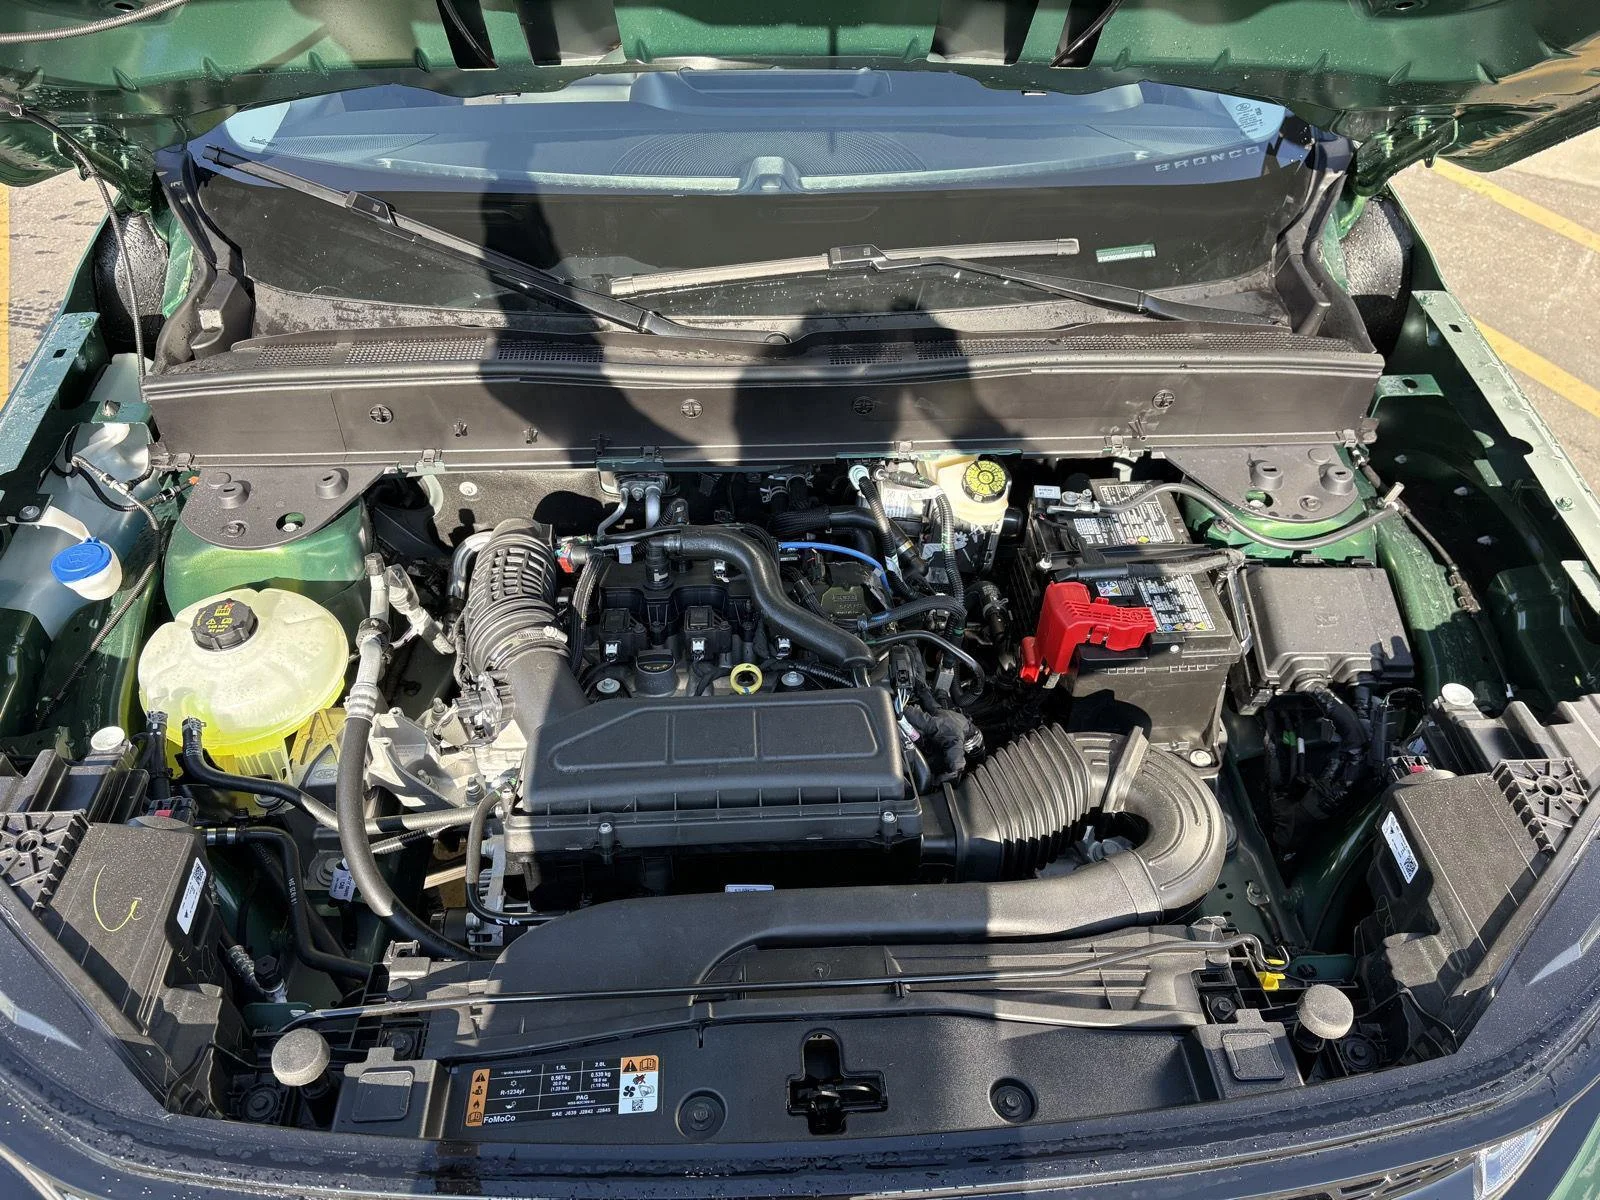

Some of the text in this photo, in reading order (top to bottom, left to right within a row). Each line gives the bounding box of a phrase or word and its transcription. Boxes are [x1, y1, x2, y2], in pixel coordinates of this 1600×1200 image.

[1154, 146, 1260, 172] BRONCO
[500, 1088, 525, 1096] R-1234yf
[483, 1114, 516, 1123] FoMoCo
